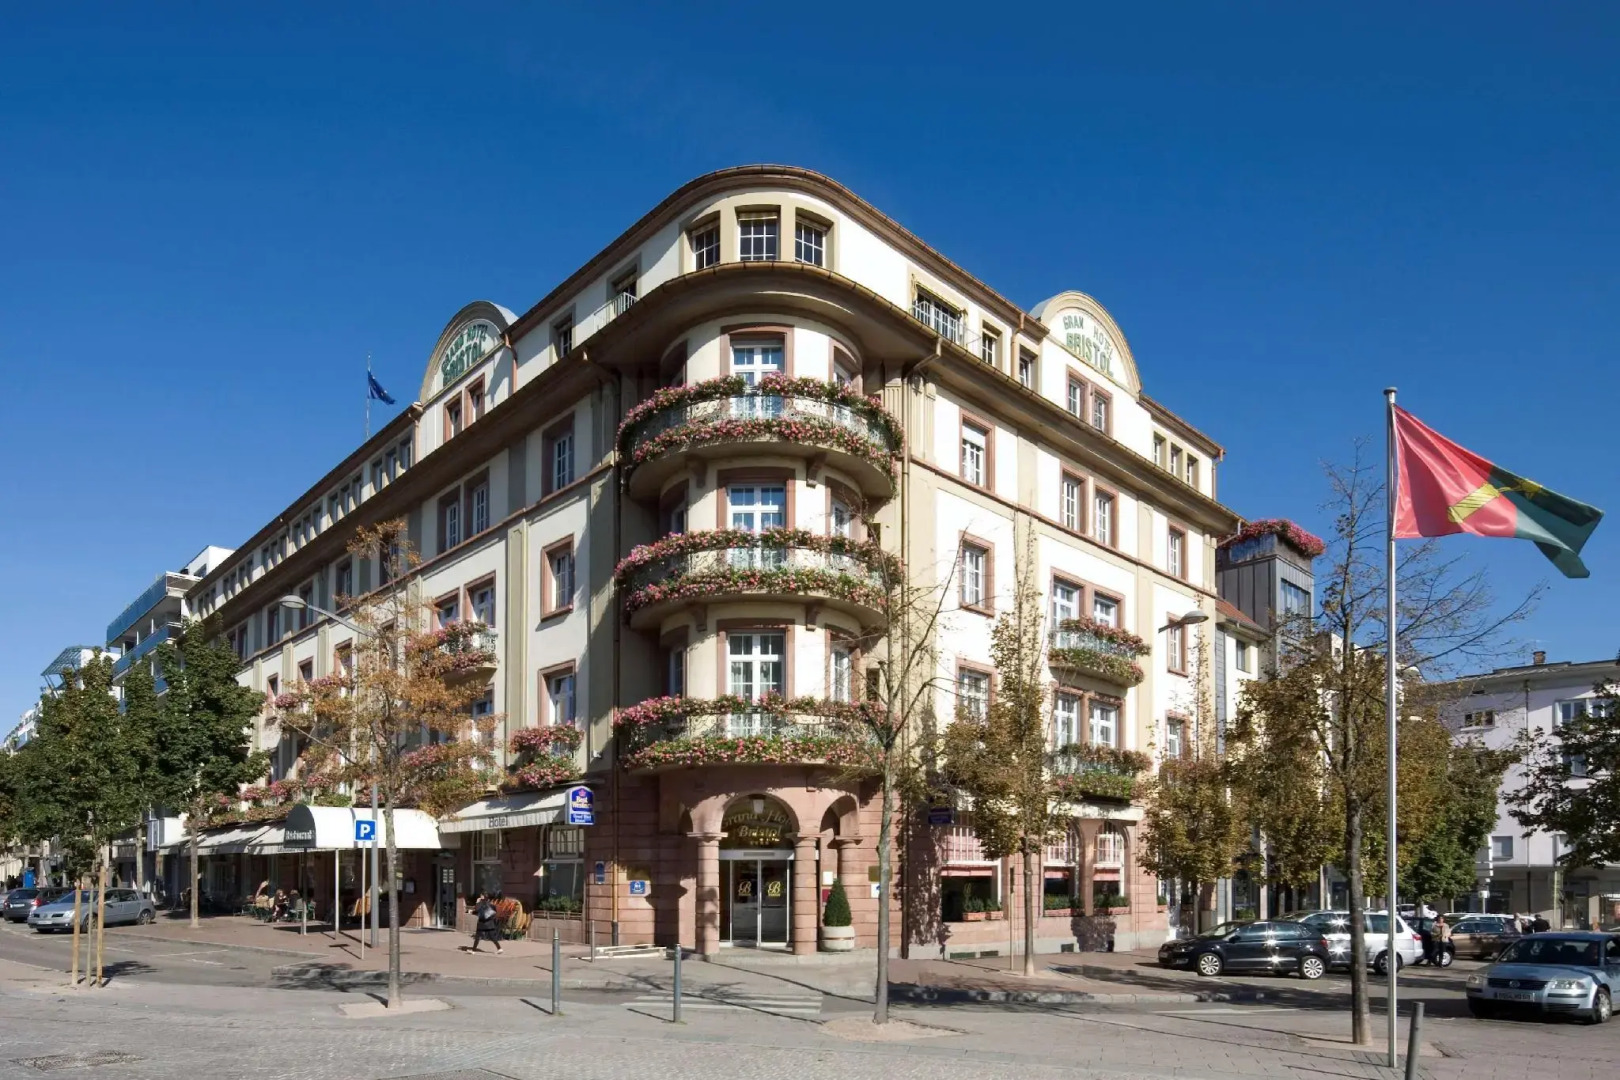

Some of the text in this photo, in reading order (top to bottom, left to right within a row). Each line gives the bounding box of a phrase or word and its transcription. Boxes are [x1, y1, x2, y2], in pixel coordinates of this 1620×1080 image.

[1066, 332, 1114, 377] BRISTOL
[1093, 325, 1113, 361] HOTEL
[442, 341, 486, 387] BRISTOL
[360, 823, 371, 838] P
[488, 816, 508, 828] Hotel
[738, 825, 783, 838] Bristol
